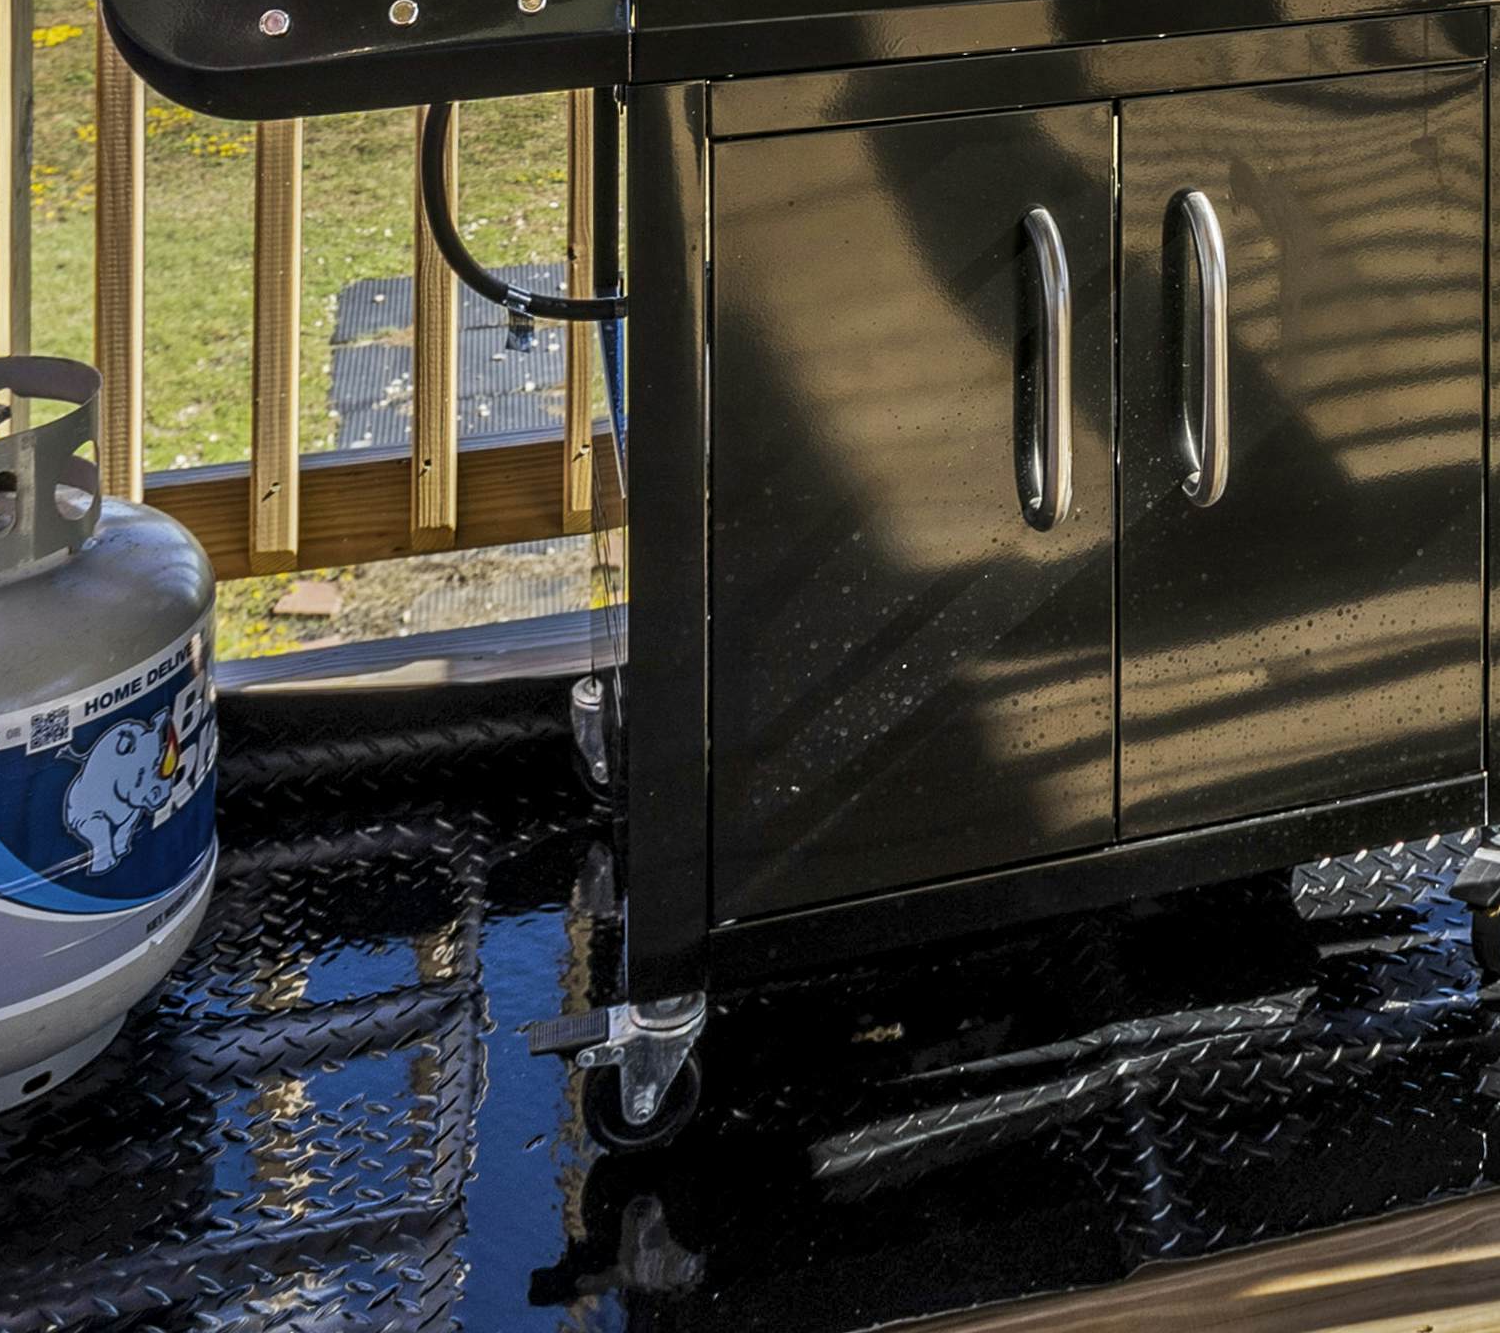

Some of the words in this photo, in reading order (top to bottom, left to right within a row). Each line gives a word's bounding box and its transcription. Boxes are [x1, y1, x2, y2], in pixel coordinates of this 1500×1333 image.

[84, 677, 142, 717] HOME
[146, 640, 193, 687] DELIVE
[5, 727, 22, 740] OR
